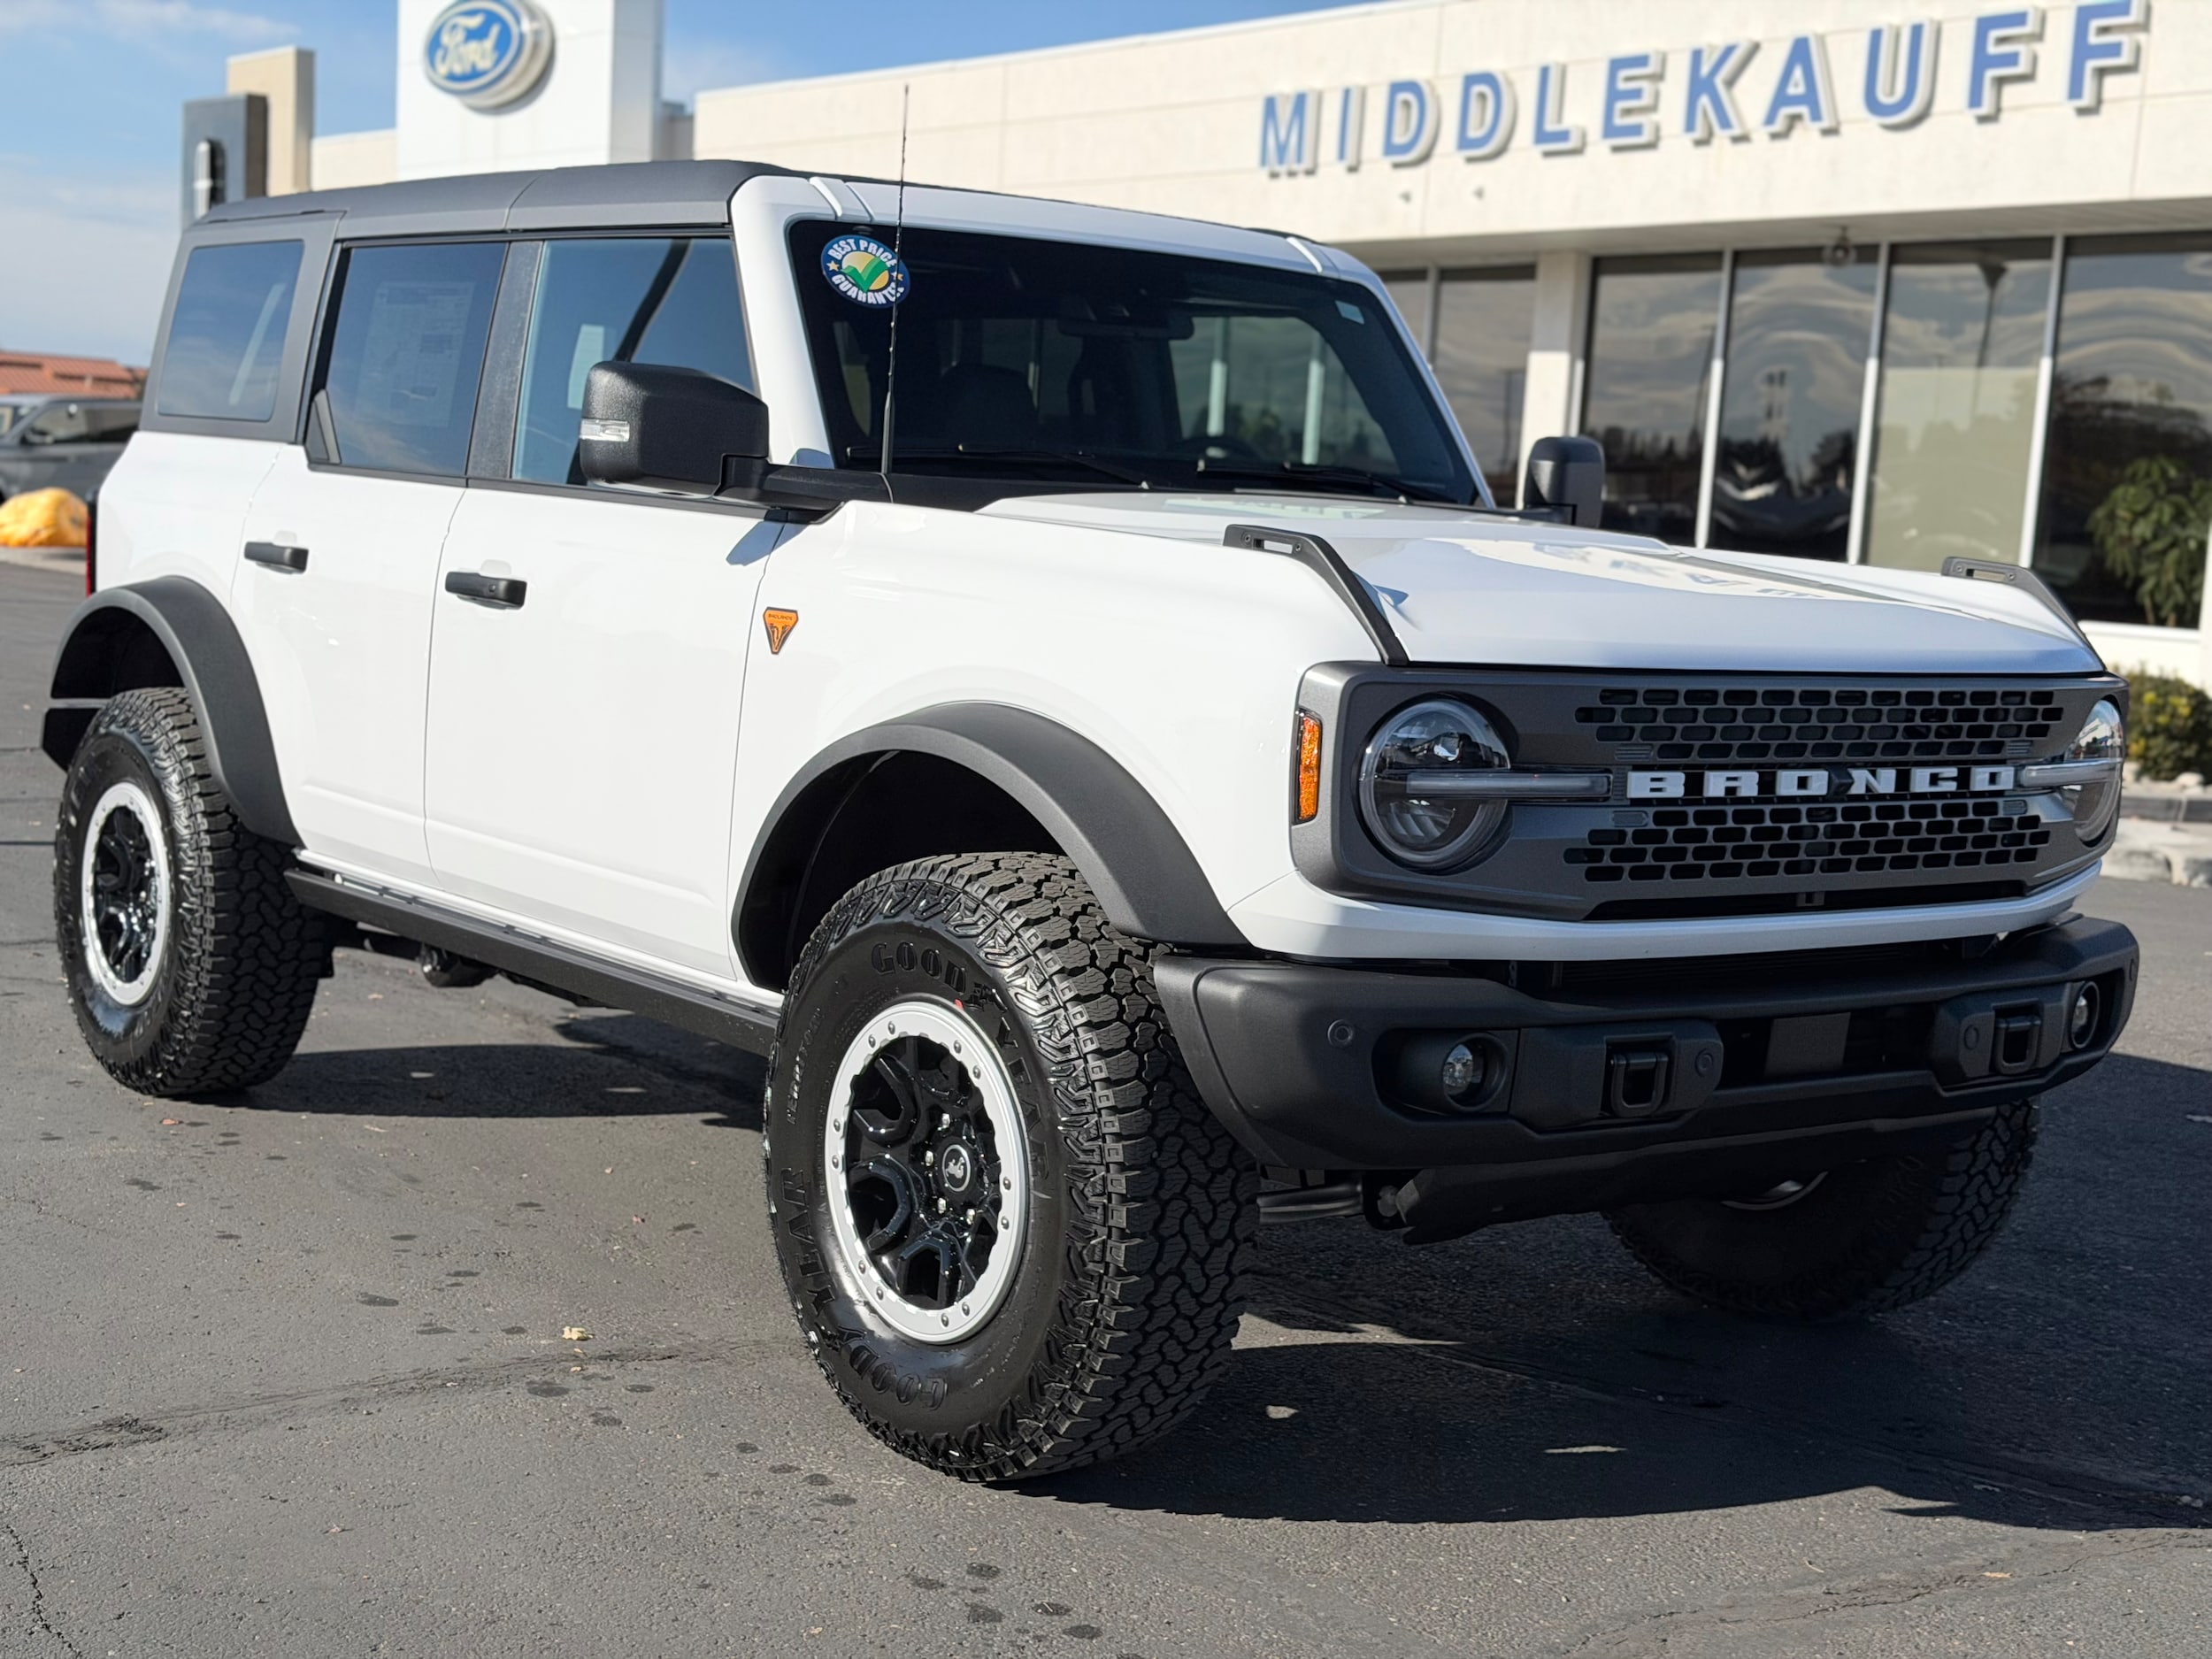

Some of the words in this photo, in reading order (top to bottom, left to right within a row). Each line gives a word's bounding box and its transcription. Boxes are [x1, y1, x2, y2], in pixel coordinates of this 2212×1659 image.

[434, 12, 501, 77] Ford
[1258, 0, 2149, 175] MIDDLEKAUFF
[828, 238, 856, 260] BEST
[859, 239, 897, 267] PRICE
[1627, 766, 2015, 798] BRONCO
